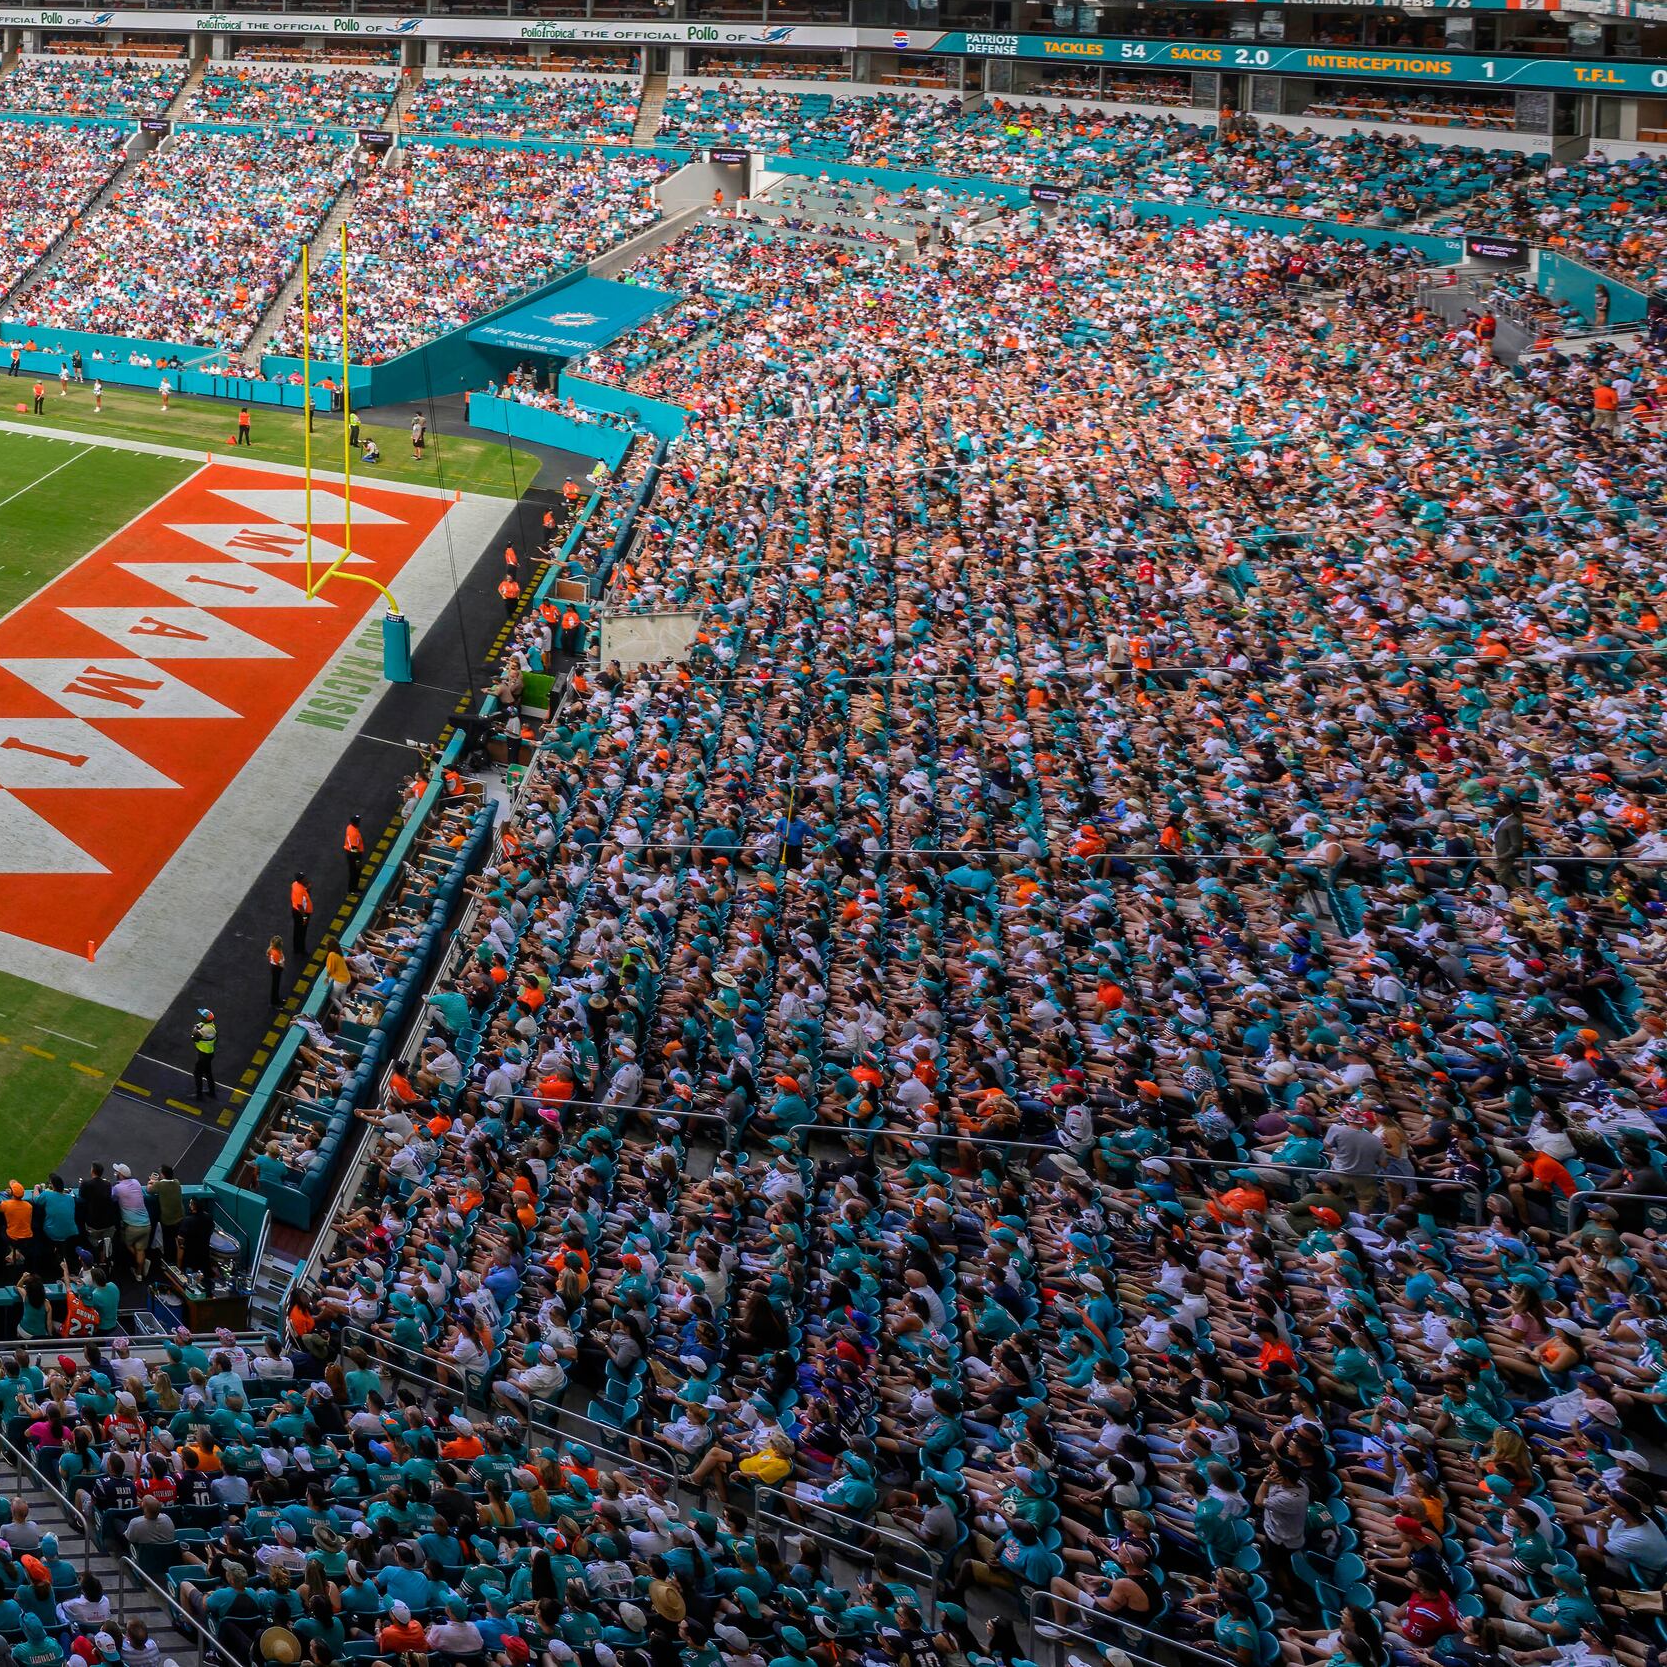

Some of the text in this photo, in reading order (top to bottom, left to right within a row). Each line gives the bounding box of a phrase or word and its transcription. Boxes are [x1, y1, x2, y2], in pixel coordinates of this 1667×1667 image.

[581, 30, 609, 39] THE
[613, 30, 682, 40] OFFICIAL
[687, 26, 718, 42] Pollo
[726, 33, 748, 42] OF
[966, 33, 1019, 46] PATRIOTS
[966, 43, 1018, 56] DEFENSE
[1043, 41, 1147, 59] TACKLES 54
[1170, 47, 1271, 65] SACKS 2.0
[1306, 54, 1495, 78] INTERCEPTIONS 1
[1573, 67, 1626, 84] T.F.L.
[1482, 244, 1519, 254] enhance
[1482, 249, 1510, 257] health
